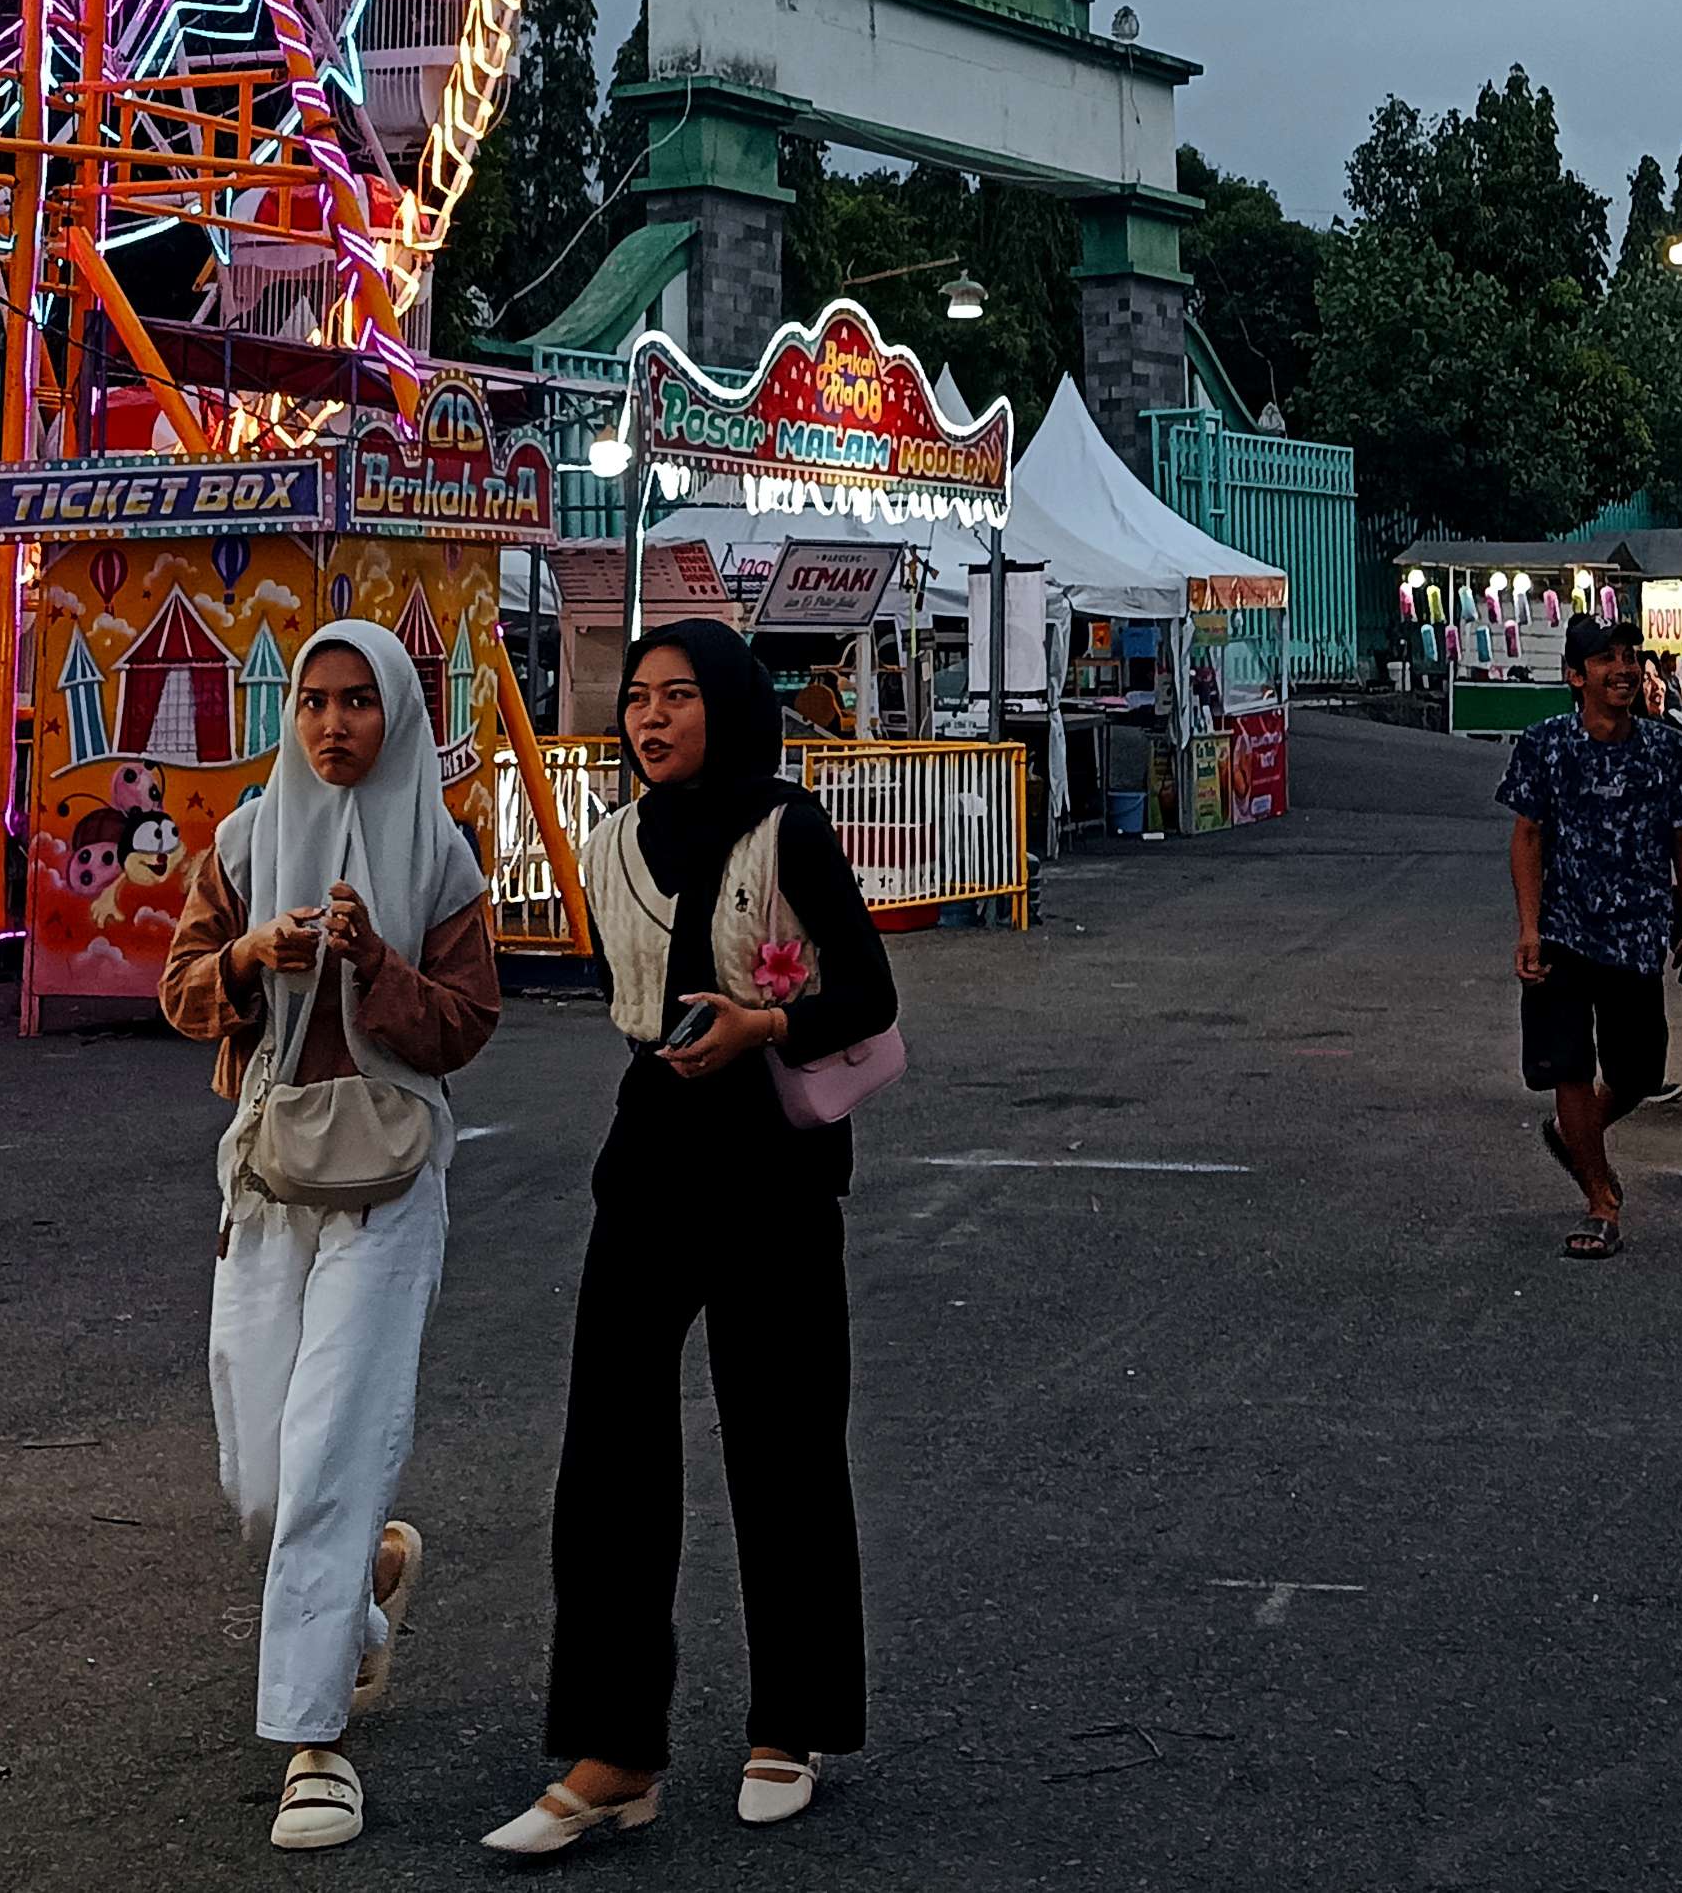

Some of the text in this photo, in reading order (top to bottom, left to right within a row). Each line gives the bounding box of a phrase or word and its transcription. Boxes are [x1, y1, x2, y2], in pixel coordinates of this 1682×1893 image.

[659, 374, 1003, 484] Pasar MALAM MODERN
[12, 472, 300, 521] TICKET BOX
[357, 452, 478, 518] Berkah
[787, 566, 879, 592] SEMAKI
